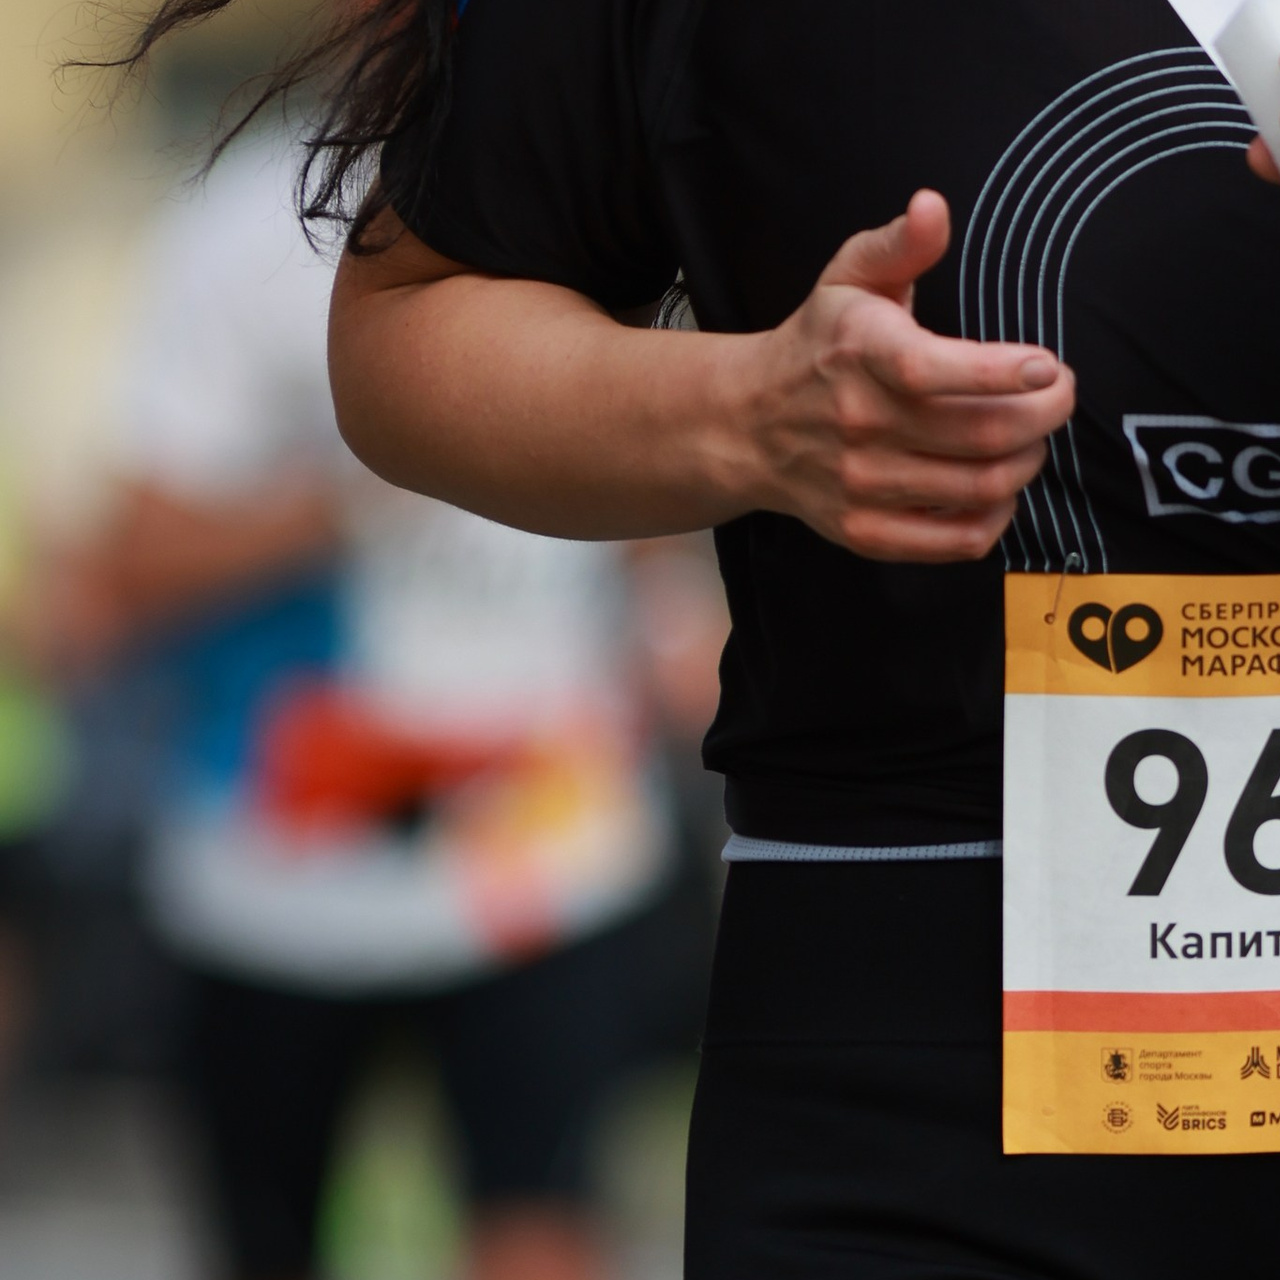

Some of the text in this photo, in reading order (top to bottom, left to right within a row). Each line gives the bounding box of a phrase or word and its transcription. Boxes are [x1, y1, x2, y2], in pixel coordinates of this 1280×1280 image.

[1139, 1049, 1203, 1060] Департамент
[1139, 1061, 1172, 1071] спорта
[1139, 1071, 1213, 1081] города Москвы
[1181, 1118, 1227, 1131] BRICS
